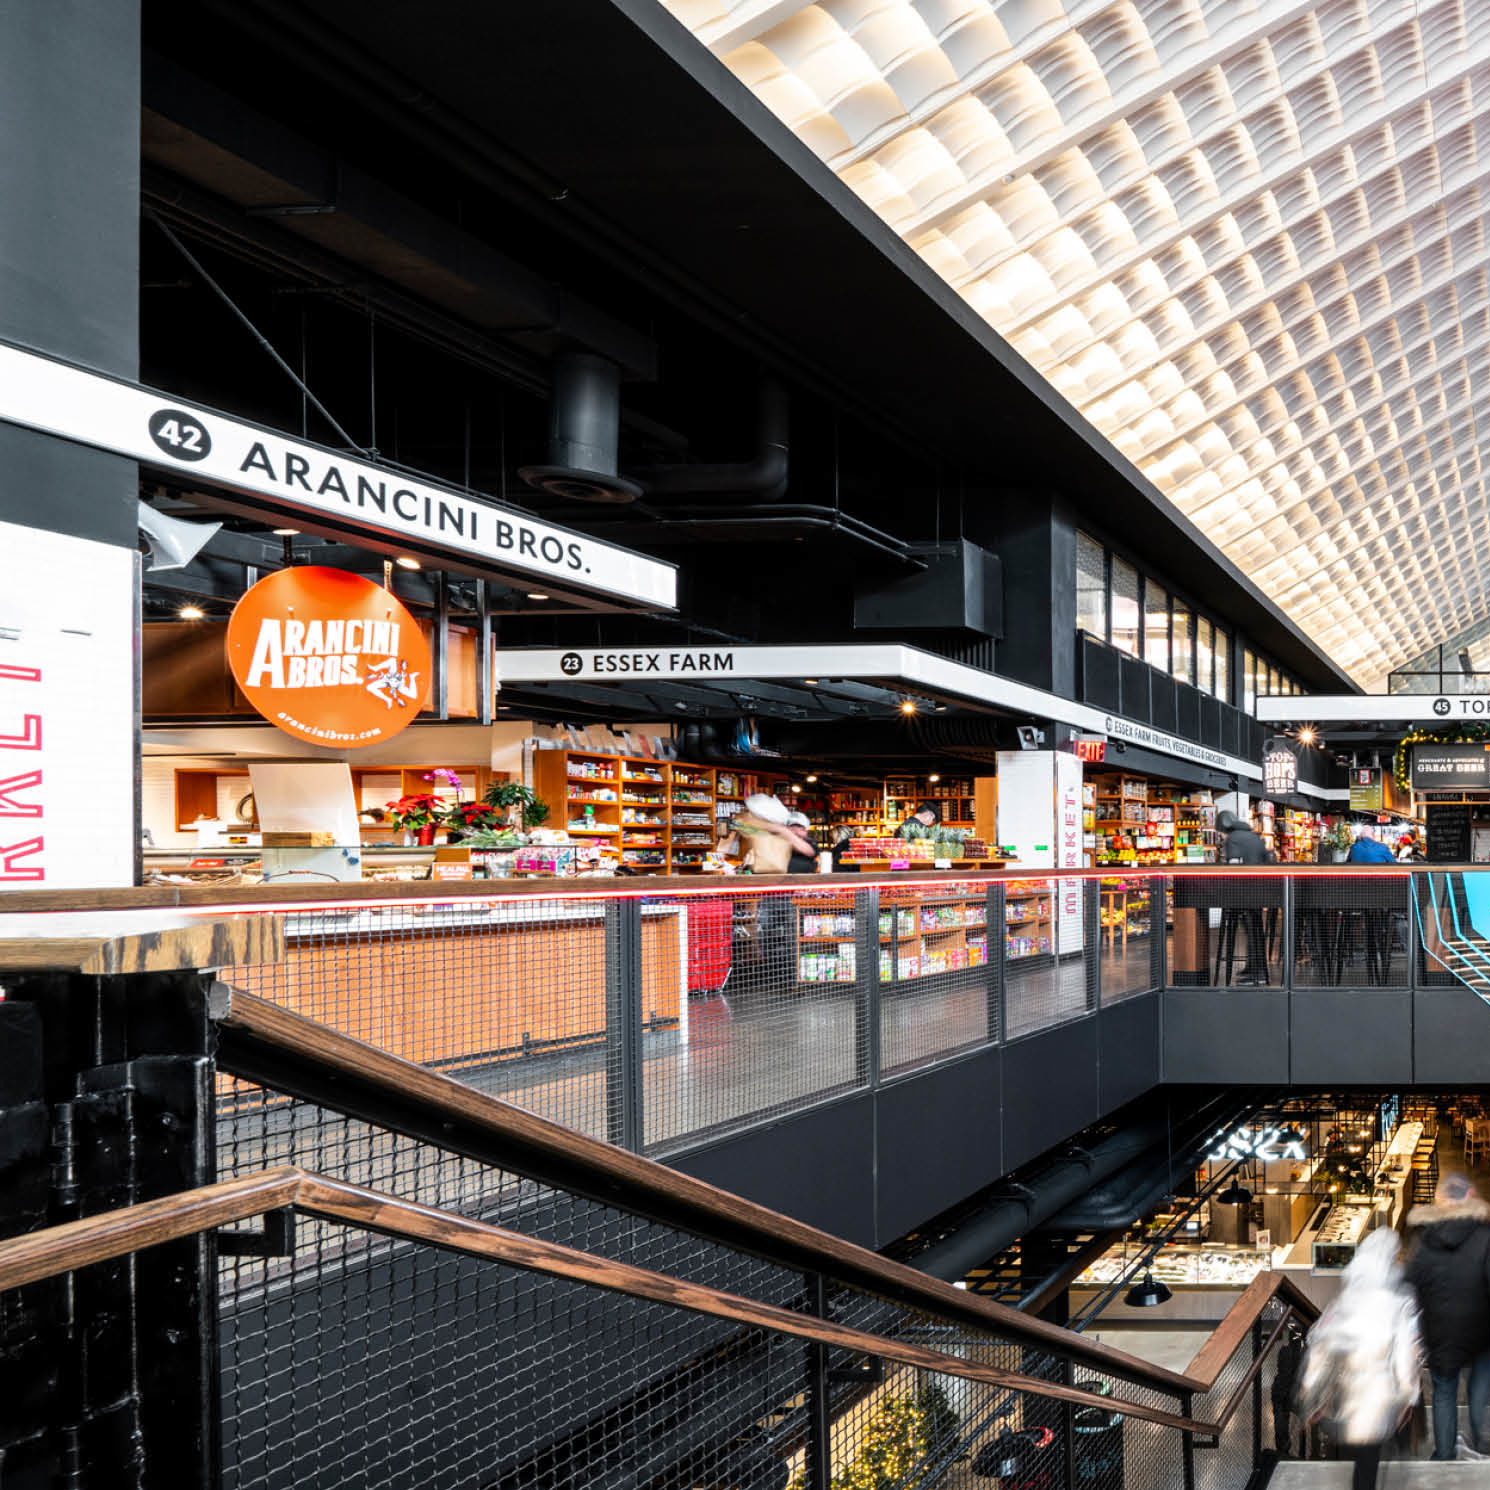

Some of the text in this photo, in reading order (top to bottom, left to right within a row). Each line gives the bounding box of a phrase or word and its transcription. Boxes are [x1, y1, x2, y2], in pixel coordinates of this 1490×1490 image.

[158, 419, 592, 574] 42 ARANCINI BROS.
[245, 618, 401, 689] ARANCINI BROS.
[563, 652, 734, 673] 23 ESSEX FARM
[1434, 700, 1450, 714] 45
[277, 711, 382, 741] arancinibros.com
[1114, 721, 1133, 738] ESSEX
[1133, 727, 1151, 742] FARM
[1077, 740, 1101, 761] EXIT
[1417, 763, 1454, 773] GREAT
